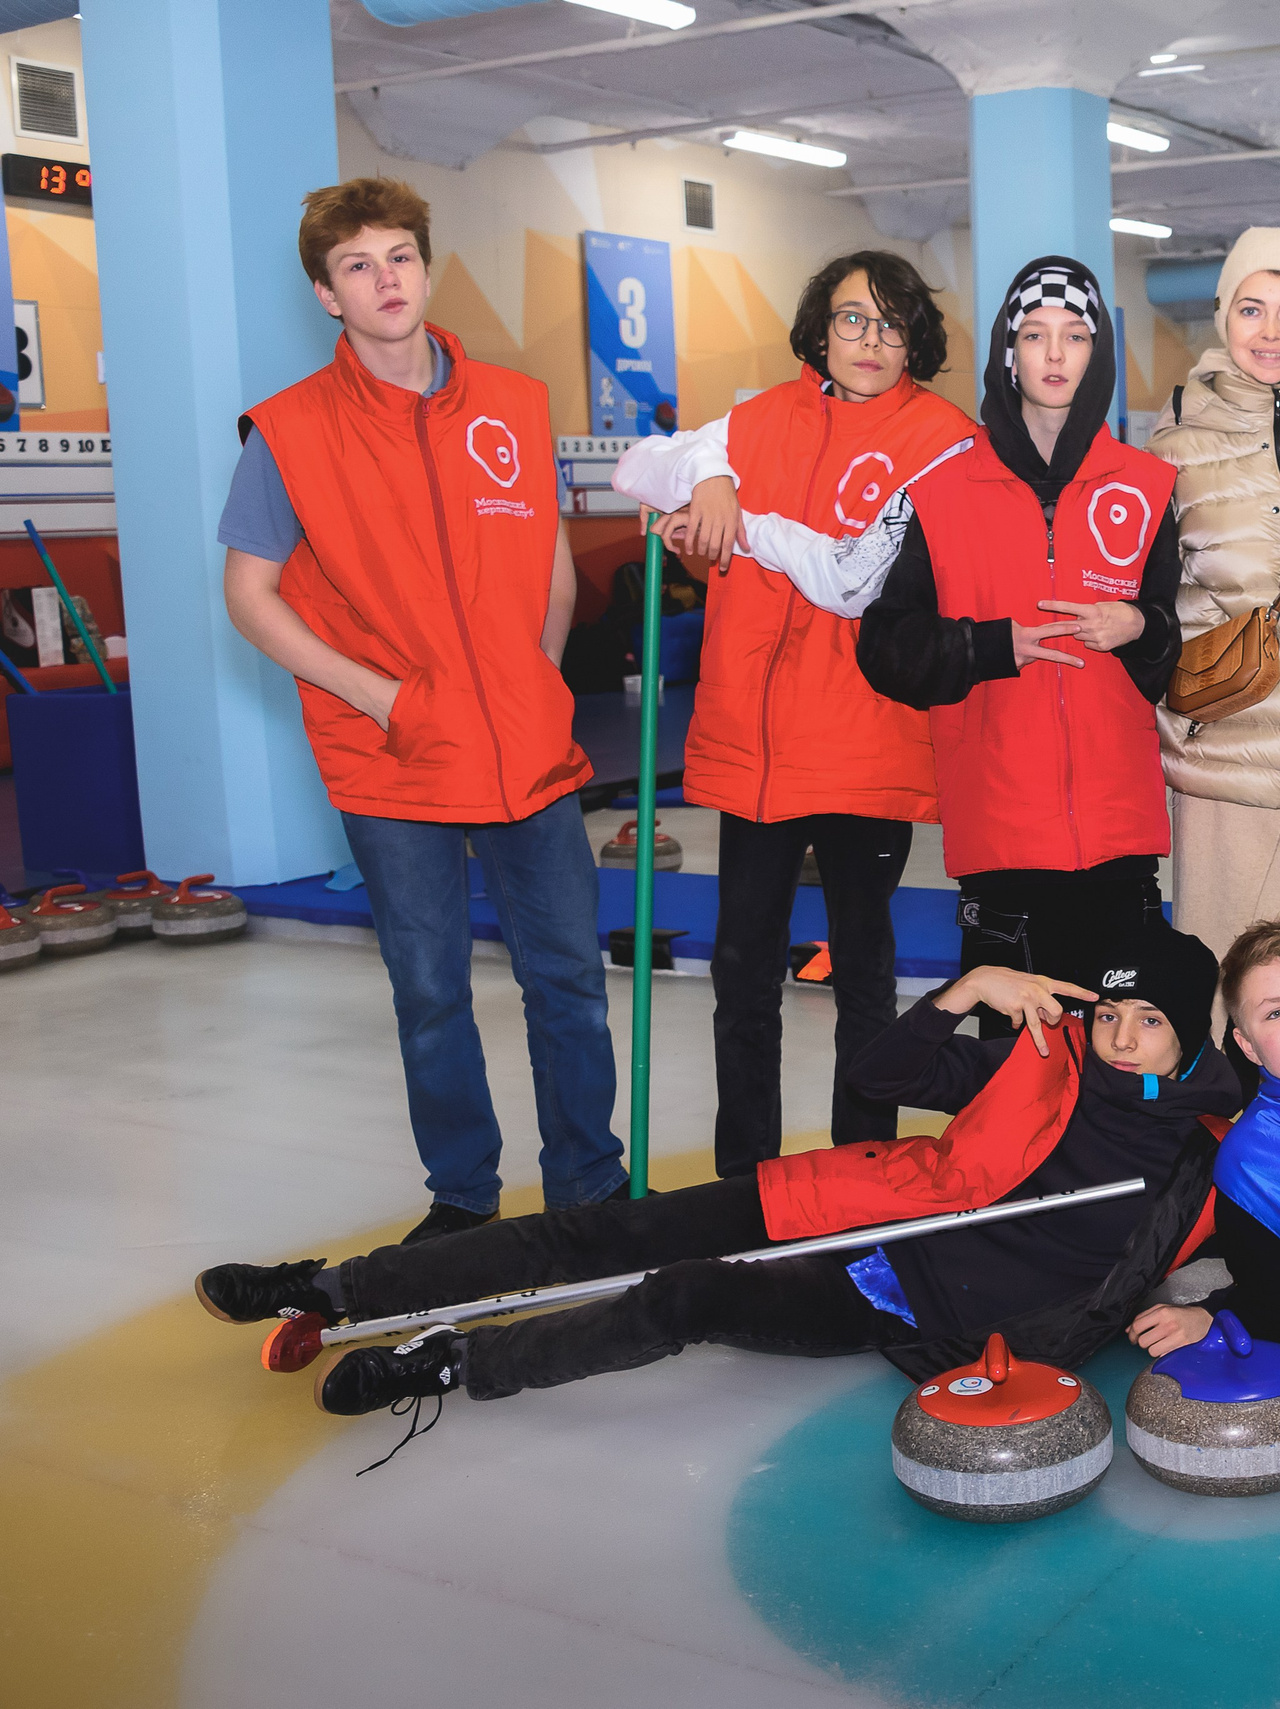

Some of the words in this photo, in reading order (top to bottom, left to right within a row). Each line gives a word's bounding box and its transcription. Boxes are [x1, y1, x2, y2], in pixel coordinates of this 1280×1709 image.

[617, 277, 648, 349] 3
[16, 438, 27, 453] 7
[38, 438, 49, 453] 8
[60, 438, 70, 453] 9
[78, 439, 95, 454] 10
[1082, 569, 1138, 589] Московский
